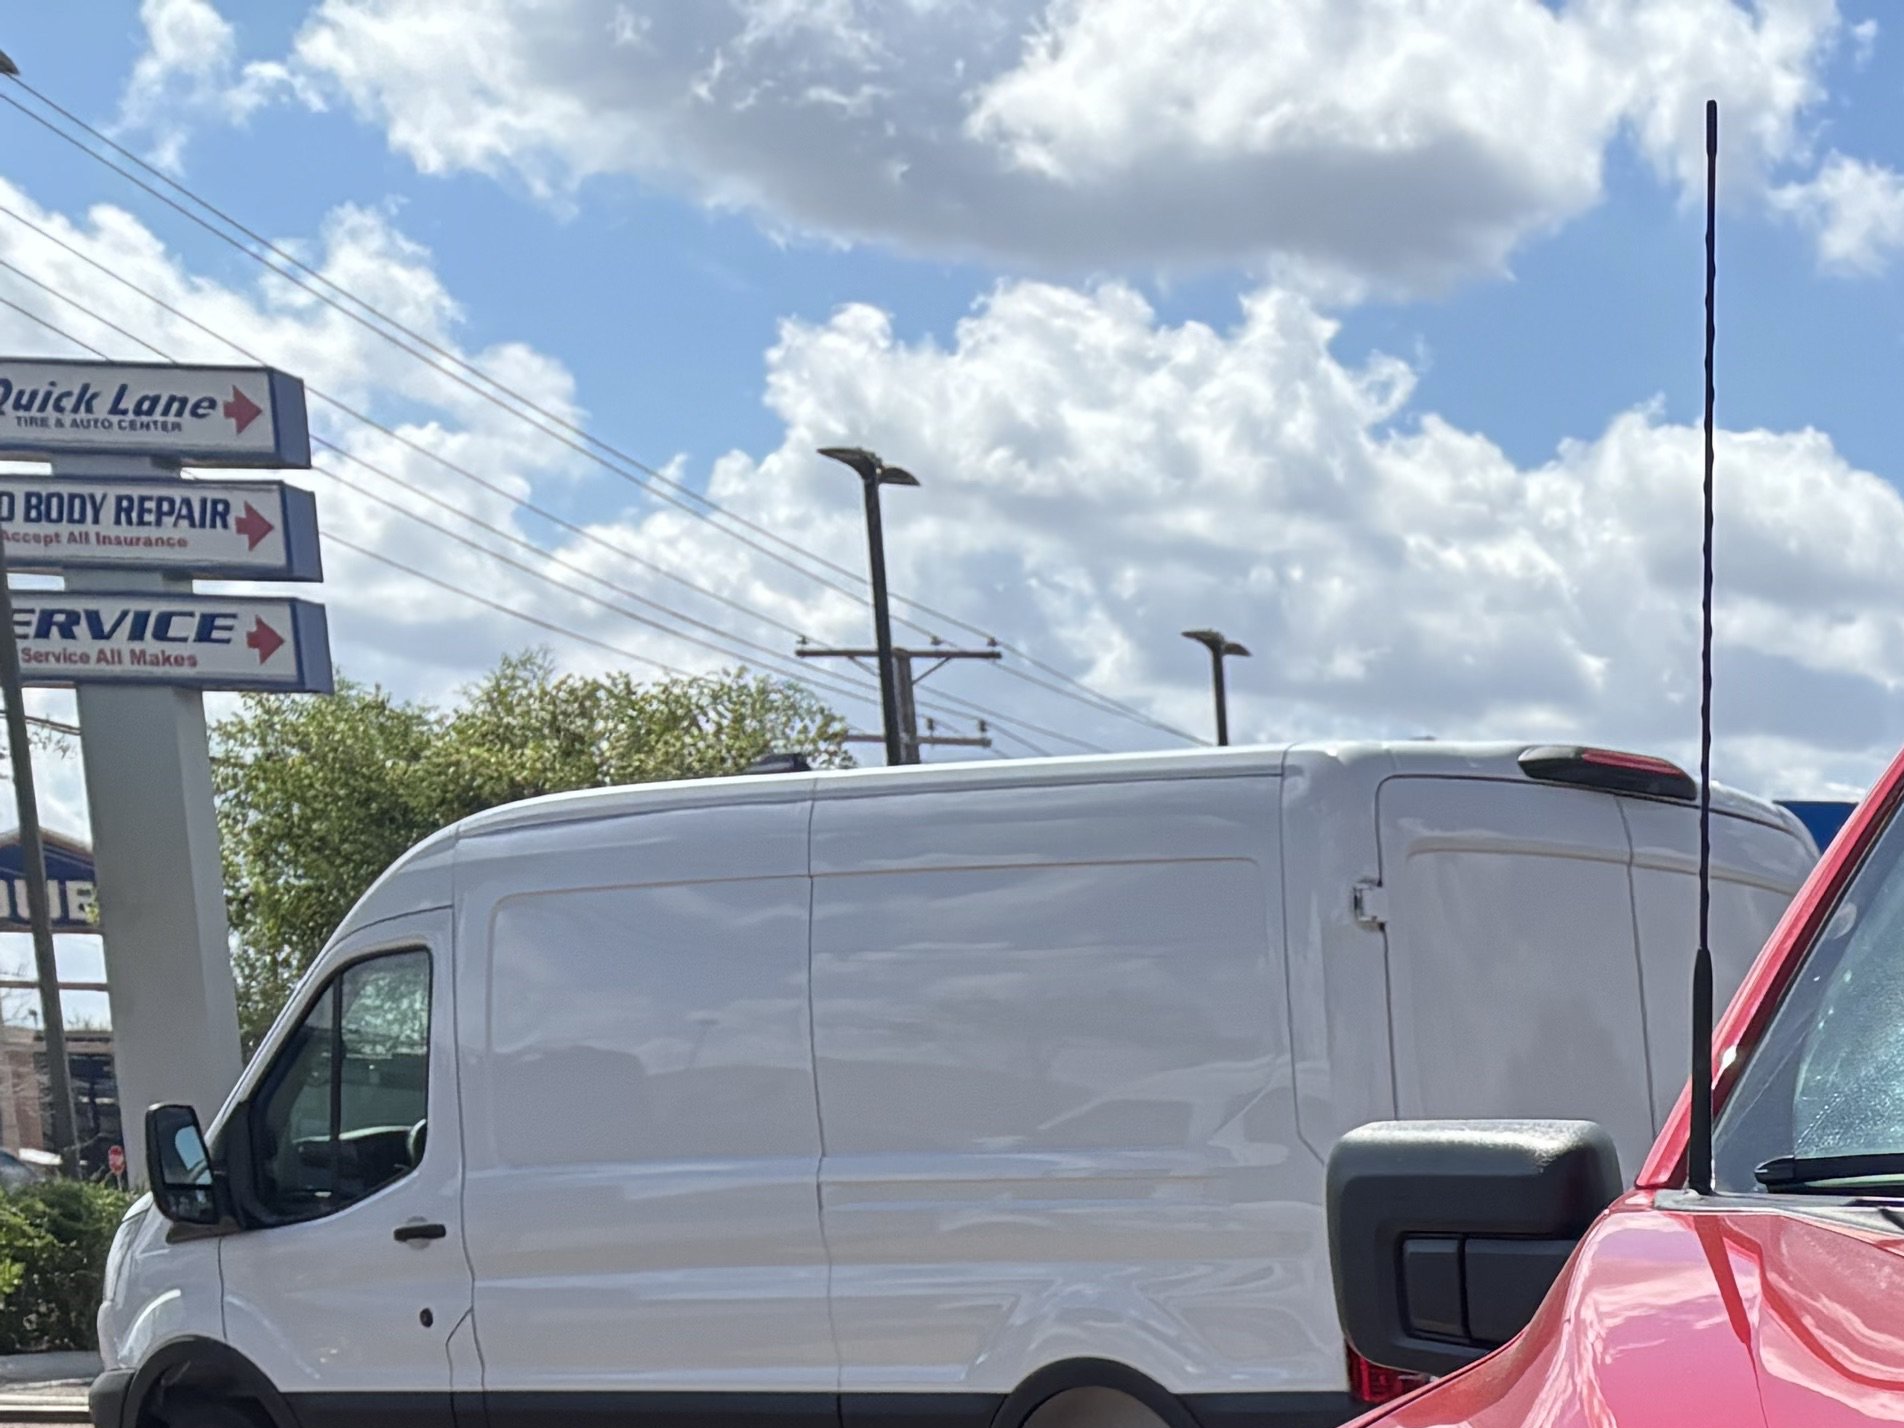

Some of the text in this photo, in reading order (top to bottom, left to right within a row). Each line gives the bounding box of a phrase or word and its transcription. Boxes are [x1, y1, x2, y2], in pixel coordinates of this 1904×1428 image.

[107, 383, 218, 419] Lane
[16, 416, 183, 434] TIRE & AUTO CENTER
[23, 491, 108, 525] BODY
[114, 494, 231, 529] REPAIR
[66, 531, 90, 545] All
[95, 531, 188, 548] Insurance
[12, 608, 238, 644] ERVICE
[21, 647, 198, 668] Service All Makes
